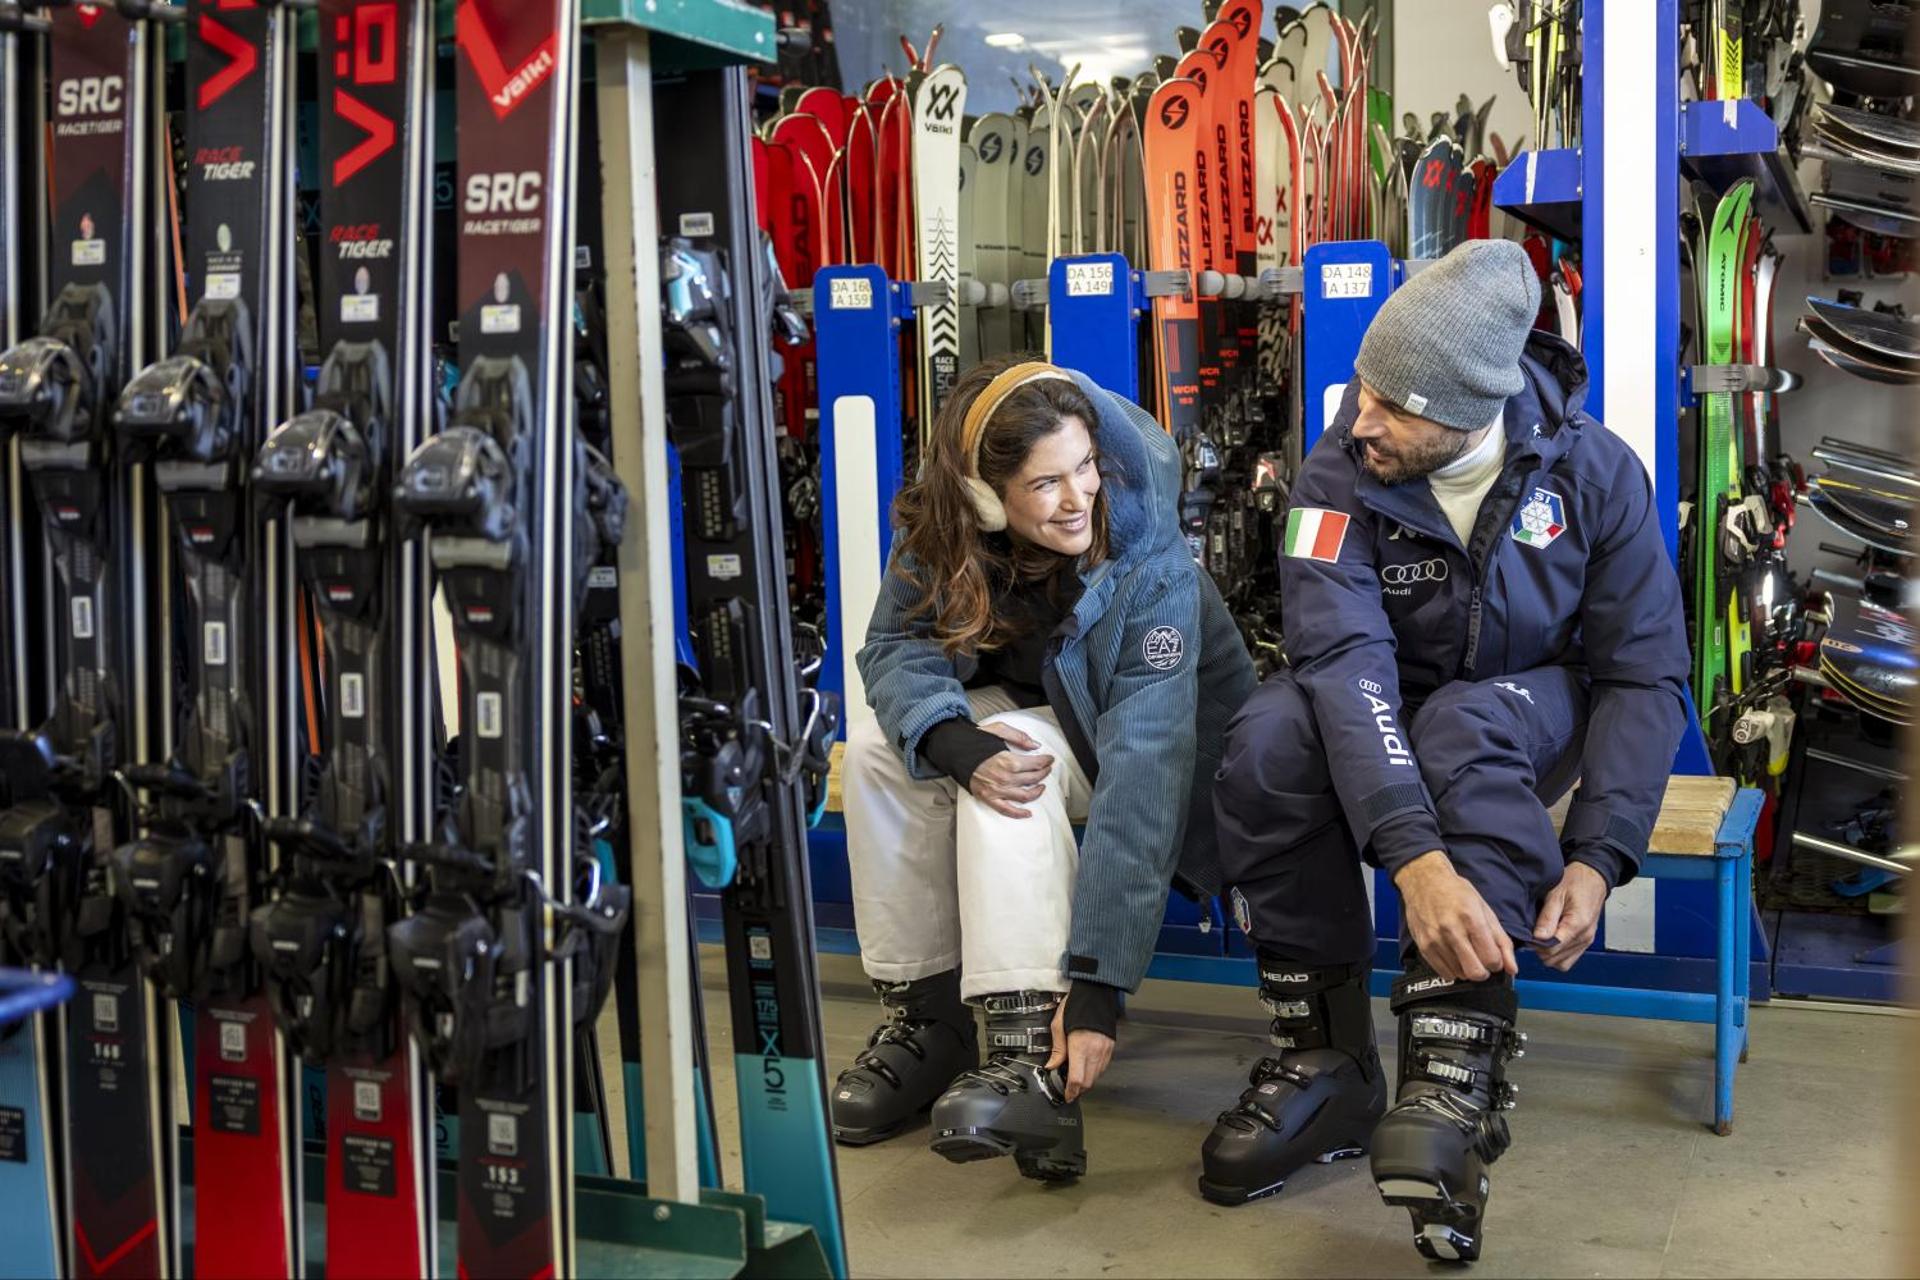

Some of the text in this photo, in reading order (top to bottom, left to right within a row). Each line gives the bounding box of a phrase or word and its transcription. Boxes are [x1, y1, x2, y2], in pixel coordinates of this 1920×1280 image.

[58, 76, 123, 115] SRC
[57, 120, 122, 136] RACETIGER
[195, 147, 242, 163] RACE
[204, 161, 255, 181] TIGER
[1239, 100, 1254, 233] BLIZZARD
[465, 171, 542, 213] SRC
[1217, 124, 1234, 260] BLIZZARD
[1196, 150, 1213, 271] LIZZARD
[329, 224, 380, 242] RACE
[464, 218, 541, 235] RACETIGER
[339, 239, 393, 259] TIGER
[1068, 266, 1112, 280] DA 156
[1324, 267, 1342, 279] DA
[831, 282, 848, 293] DA
[1073, 281, 1108, 294] A 149
[1330, 282, 1367, 295] A 137
[836, 294, 844, 305] A
[935, 356, 955, 364] RACE
[1382, 587, 1412, 596] Audi
[1147, 638, 1179, 655] EA7
[1362, 692, 1414, 766] Audi
[1263, 971, 1309, 983] HEAD
